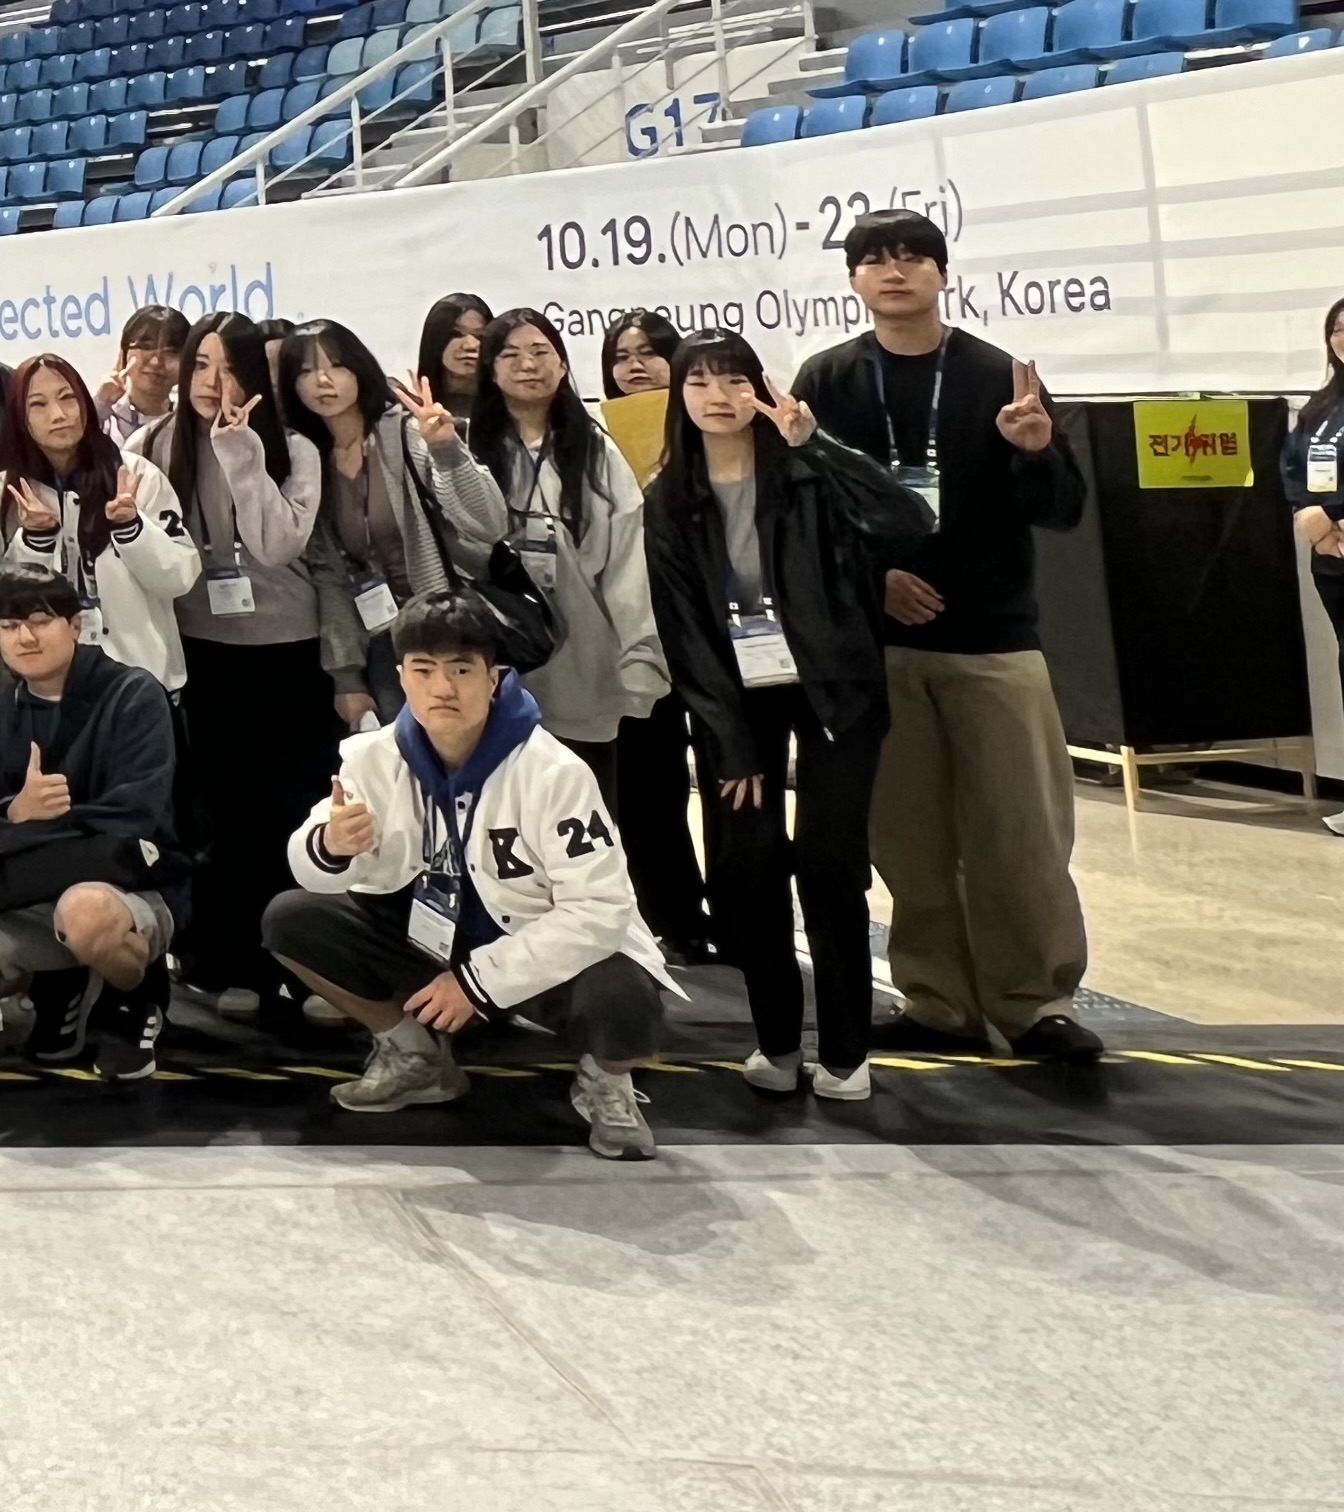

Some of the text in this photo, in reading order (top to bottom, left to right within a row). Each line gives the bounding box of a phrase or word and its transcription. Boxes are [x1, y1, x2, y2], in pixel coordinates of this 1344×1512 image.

[625, 91, 721, 157] G17
[997, 269, 1112, 319] Korea
[488, 827, 534, 880] K
[557, 809, 614, 859] 24
